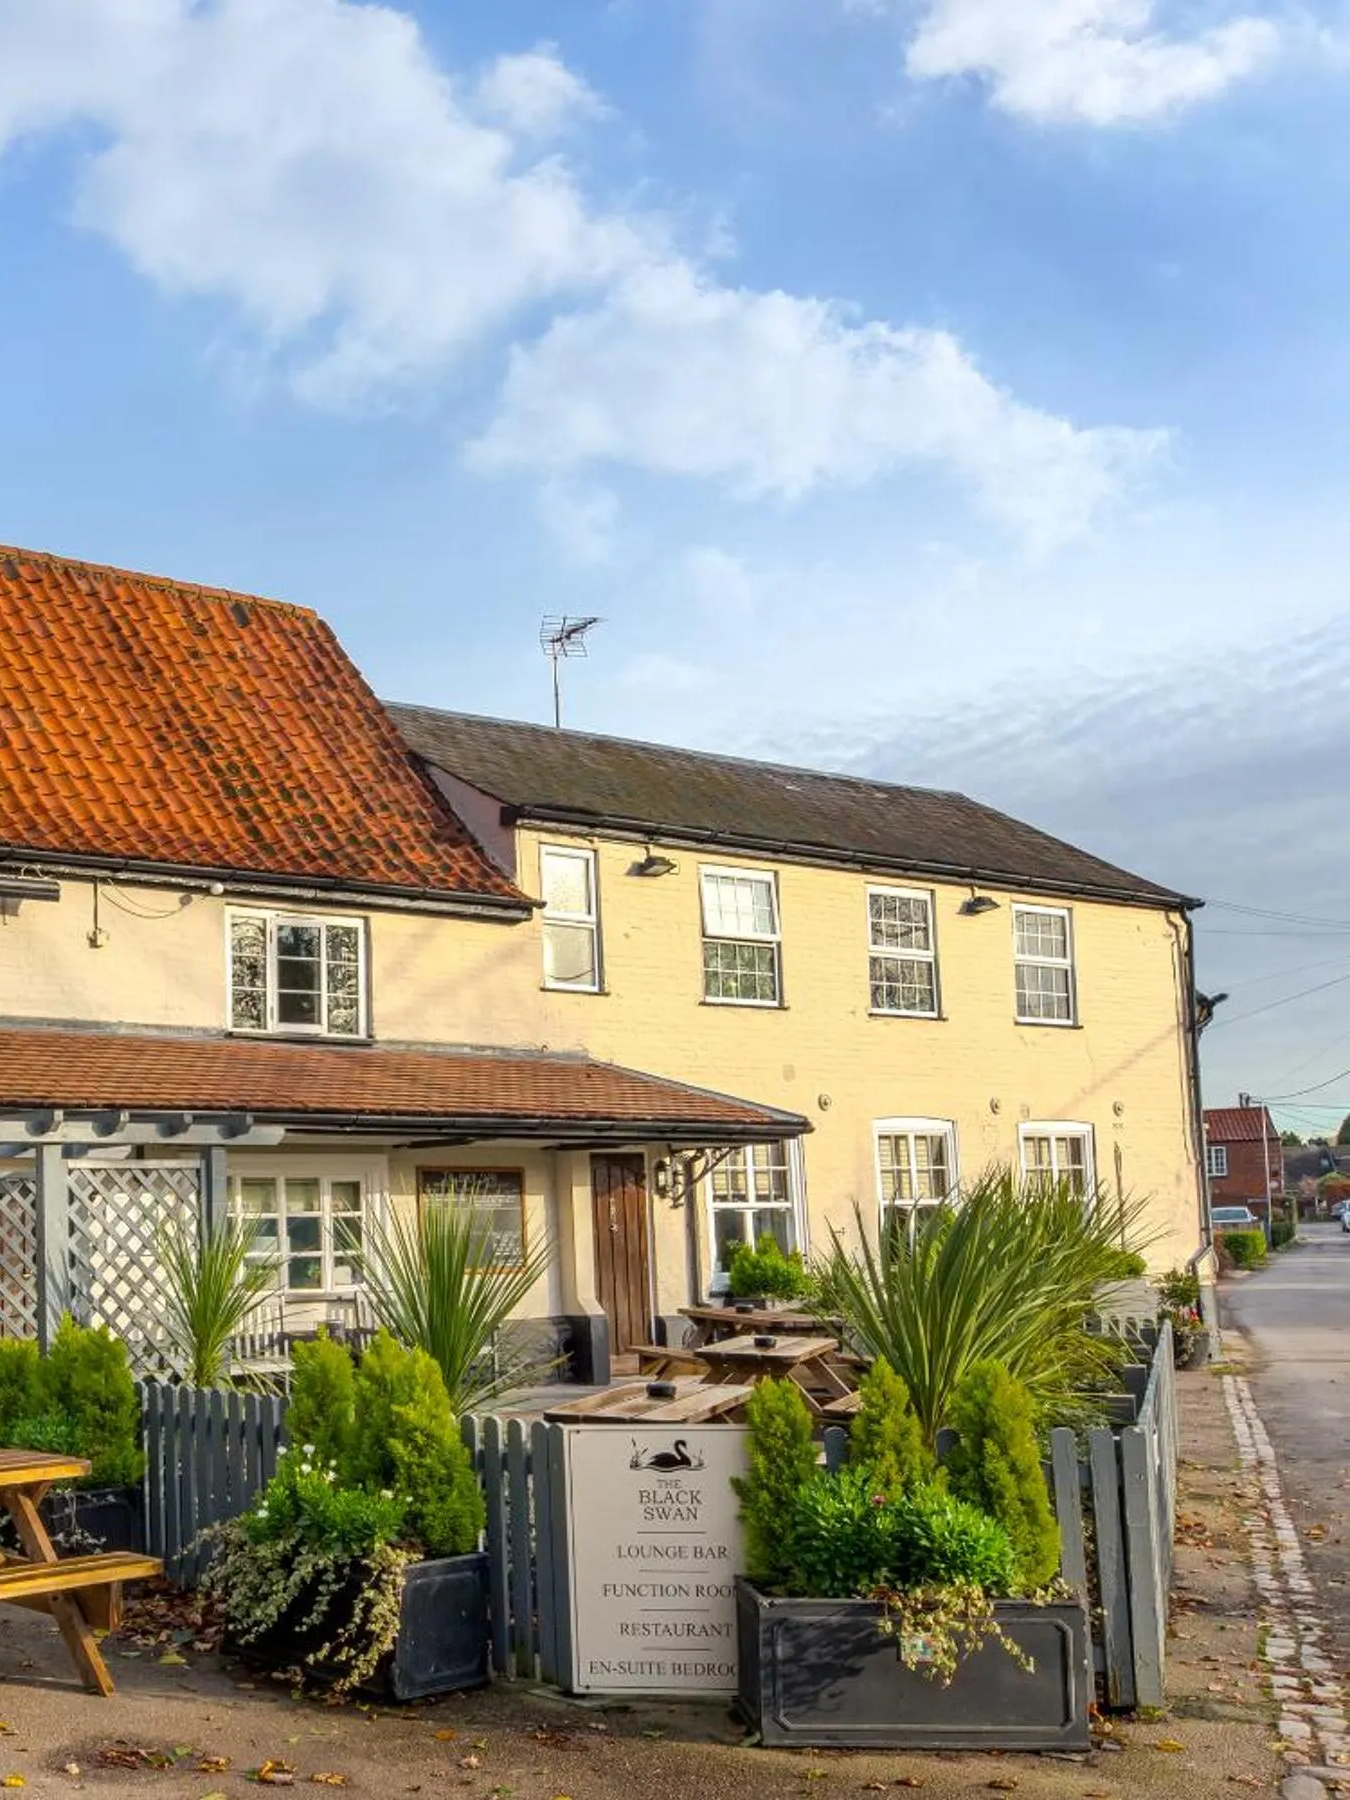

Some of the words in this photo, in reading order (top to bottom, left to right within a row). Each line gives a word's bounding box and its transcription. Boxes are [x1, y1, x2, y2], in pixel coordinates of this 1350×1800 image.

[657, 1479, 682, 1489] THE
[639, 1490, 702, 1505] BLACK
[643, 1506, 698, 1521] SWAN
[617, 1545, 688, 1560] LOUNGE
[693, 1546, 728, 1560] BAR
[603, 1584, 691, 1598] FUNCTION
[620, 1623, 734, 1638] RESTAURANT
[589, 1661, 665, 1675] EN-SUITE
